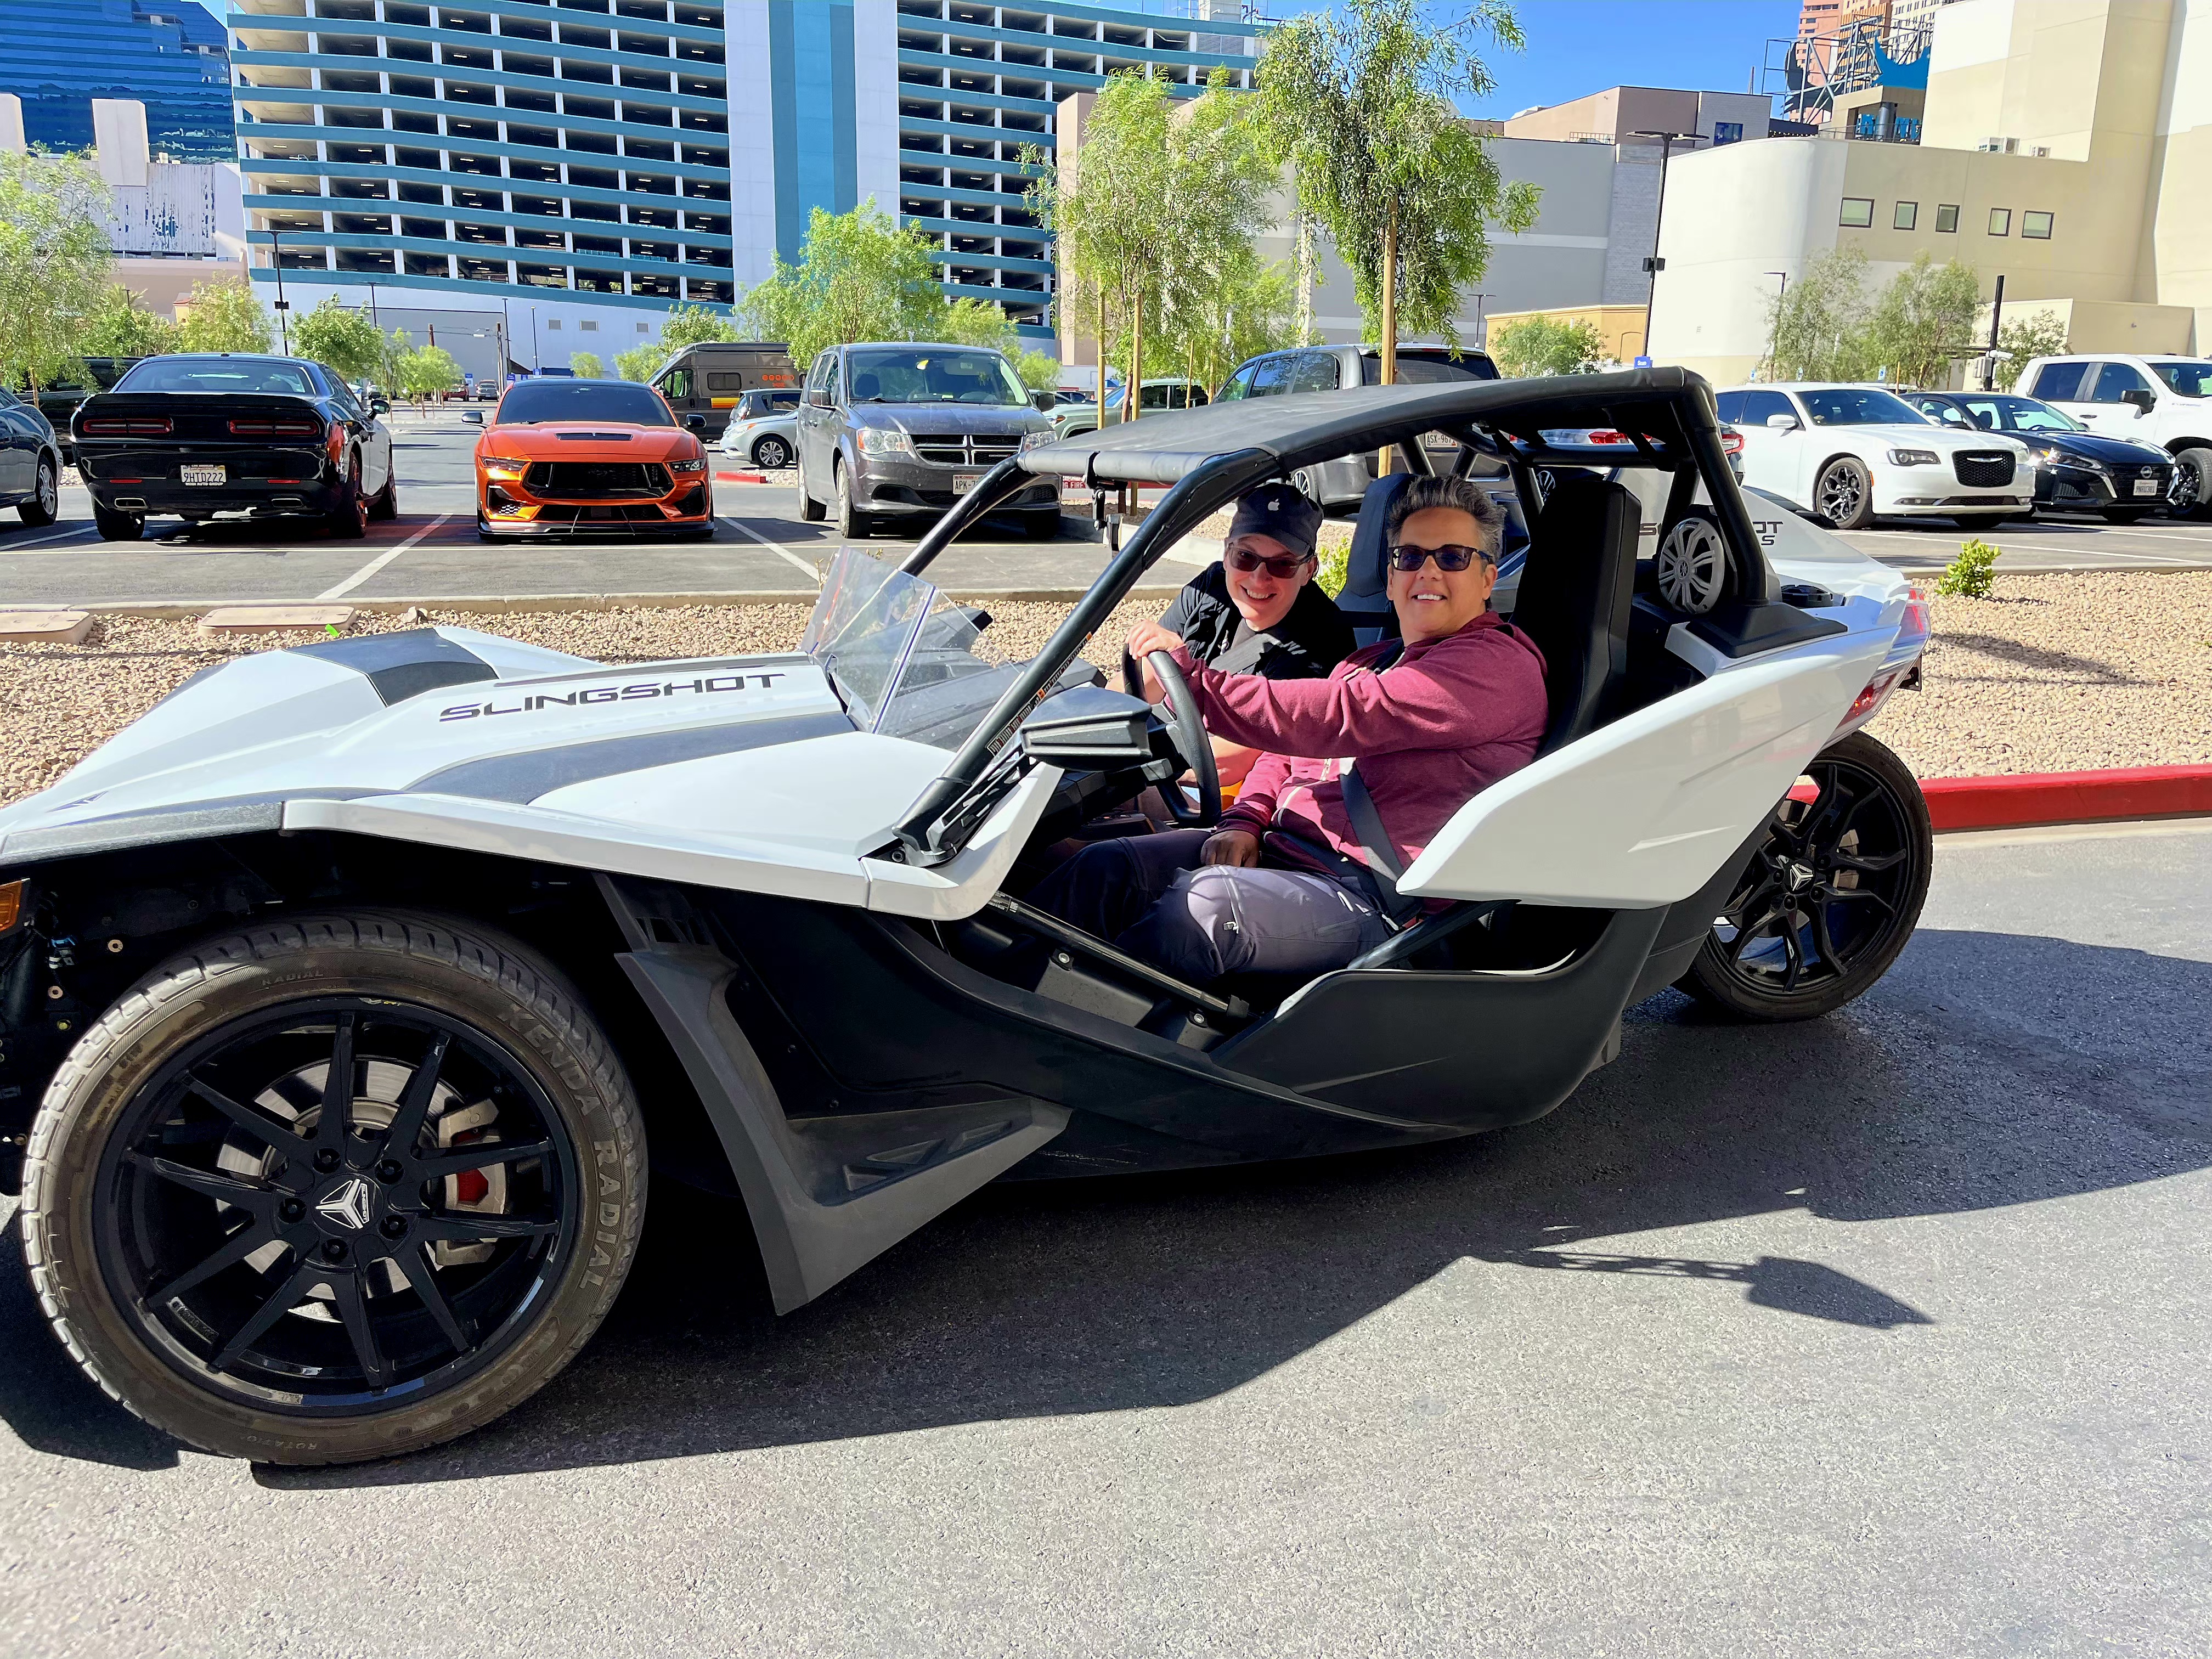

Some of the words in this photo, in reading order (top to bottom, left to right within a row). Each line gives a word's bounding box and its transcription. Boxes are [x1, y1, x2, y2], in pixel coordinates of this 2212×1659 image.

[955, 480, 979, 490] APK-7
[439, 673, 787, 723] SLINGSHOT
[496, 1003, 601, 1116] KENDA
[579, 1139, 621, 1289] RADIAL
